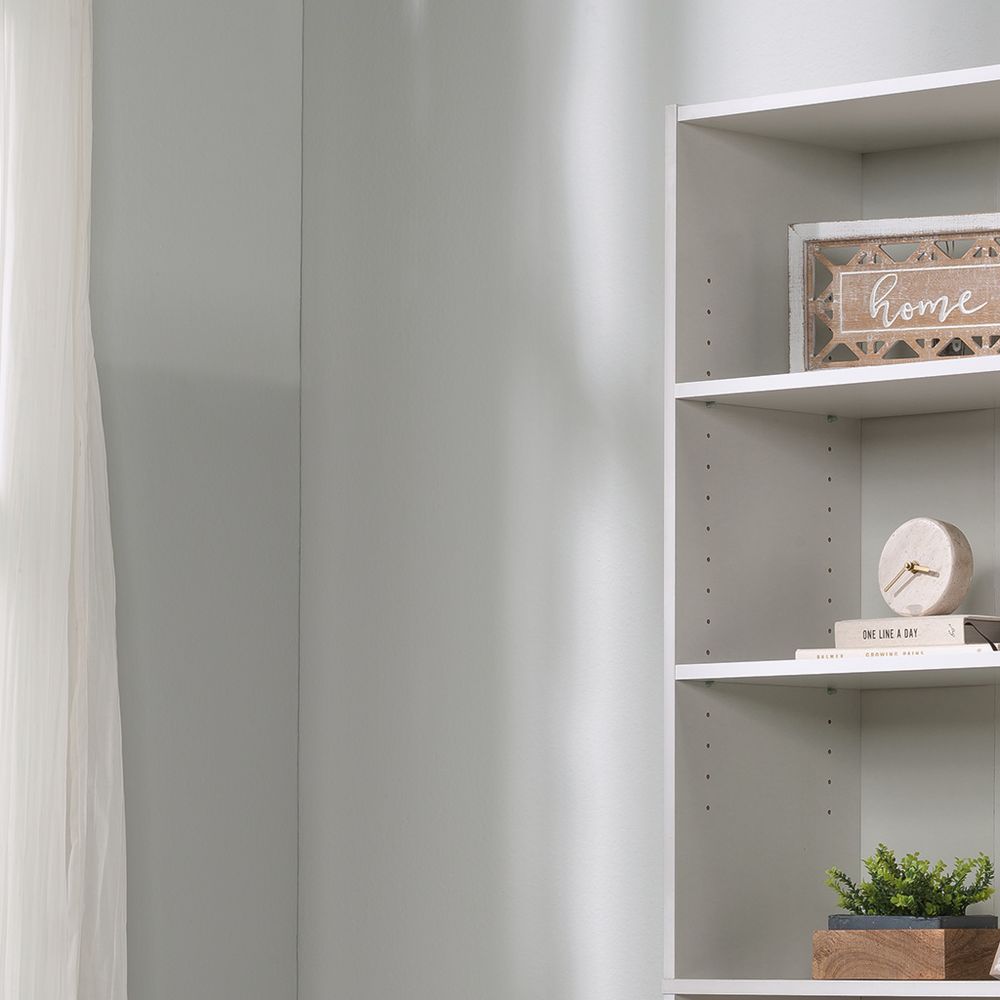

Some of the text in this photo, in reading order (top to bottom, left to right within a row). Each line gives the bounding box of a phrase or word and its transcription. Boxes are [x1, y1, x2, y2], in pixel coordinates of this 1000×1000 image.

[869, 273, 988, 328] home
[862, 628, 918, 640] ONE LINE A DAY
